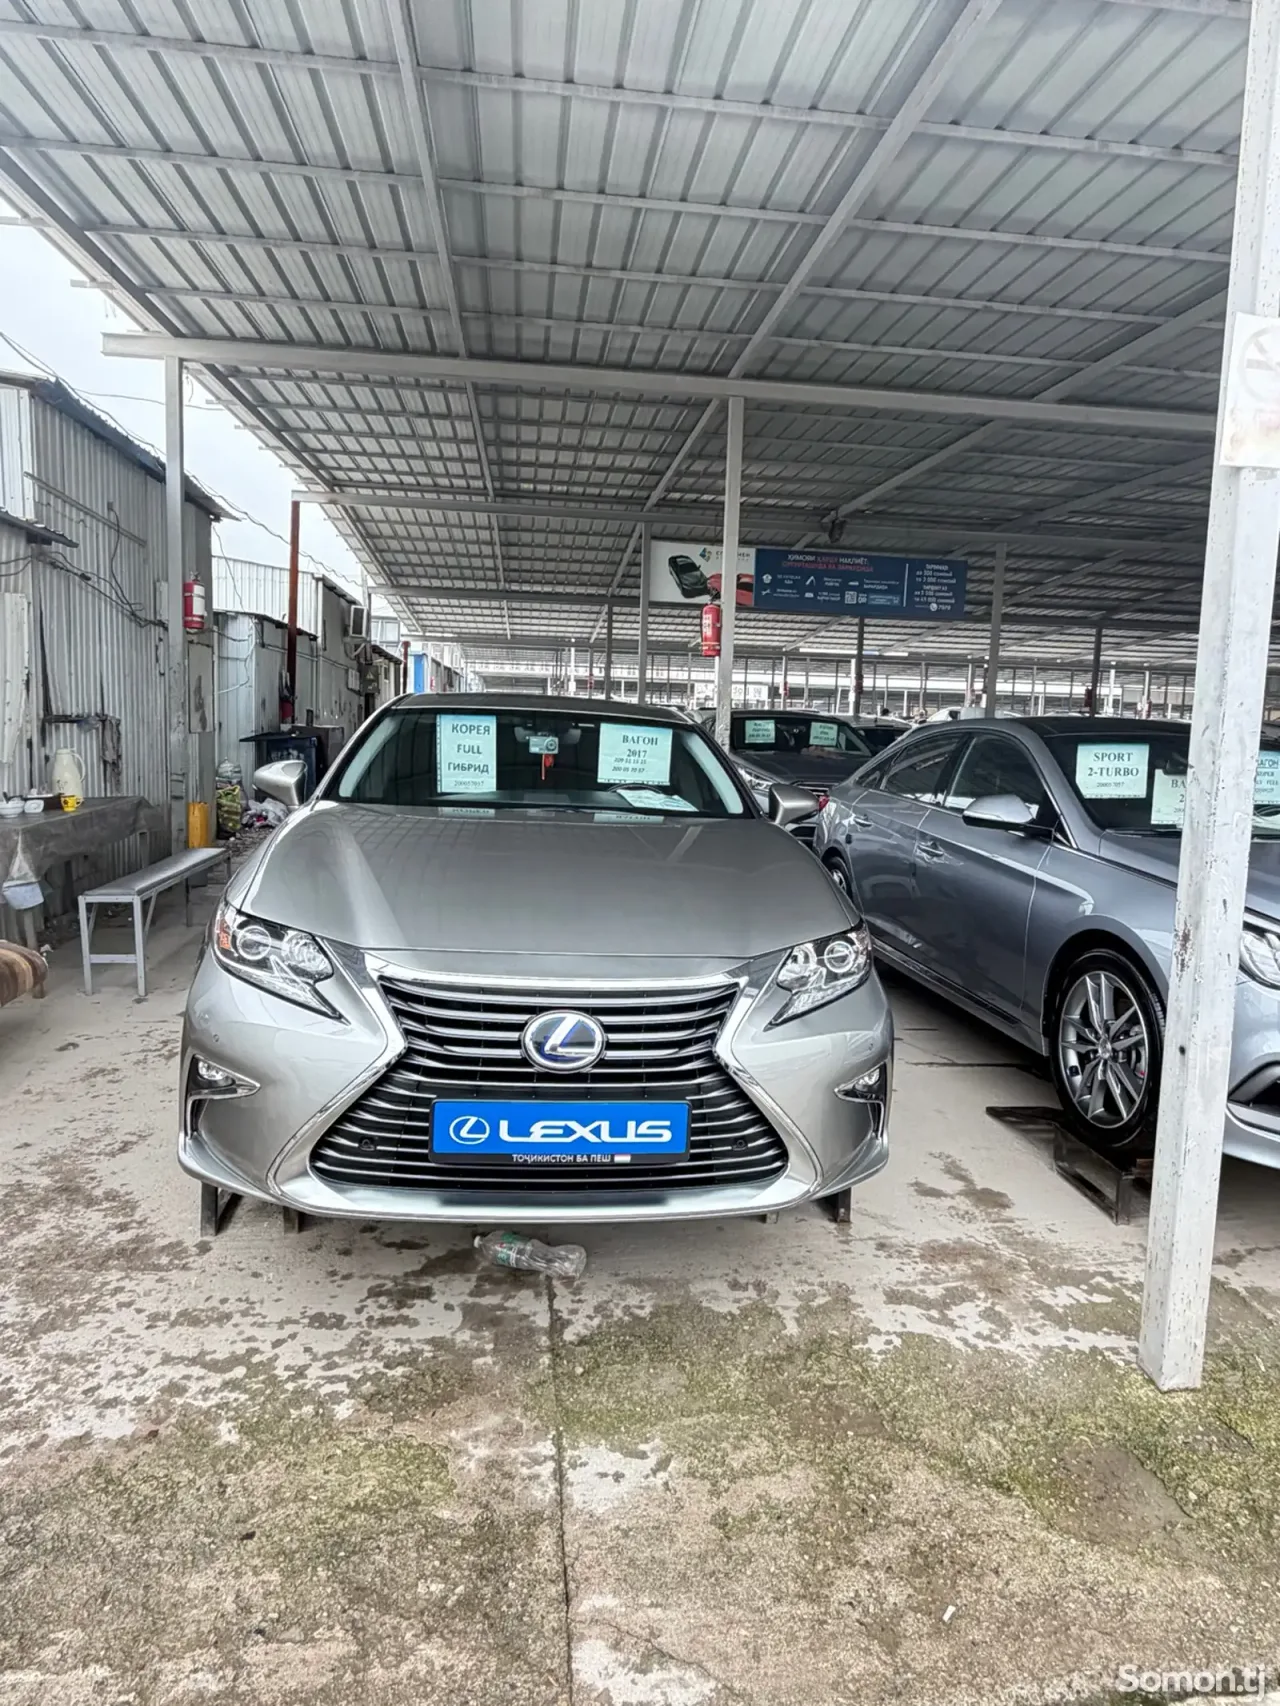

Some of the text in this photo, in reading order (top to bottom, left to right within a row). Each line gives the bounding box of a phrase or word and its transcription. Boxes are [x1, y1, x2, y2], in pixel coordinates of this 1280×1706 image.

[451, 723, 491, 736] КОРЕЯ
[622, 734, 659, 746] ВАГОН
[456, 743, 483, 755] FULL
[627, 748, 647, 758] 2017
[1093, 752, 1134, 762] SPORT
[448, 762, 490, 775] ГИБРИД
[1087, 767, 1140, 777] 2-TURBO
[499, 1120, 673, 1143] LEXUS
[576, 1154, 589, 1163] БА
[590, 1154, 611, 1163] ПЕШ
